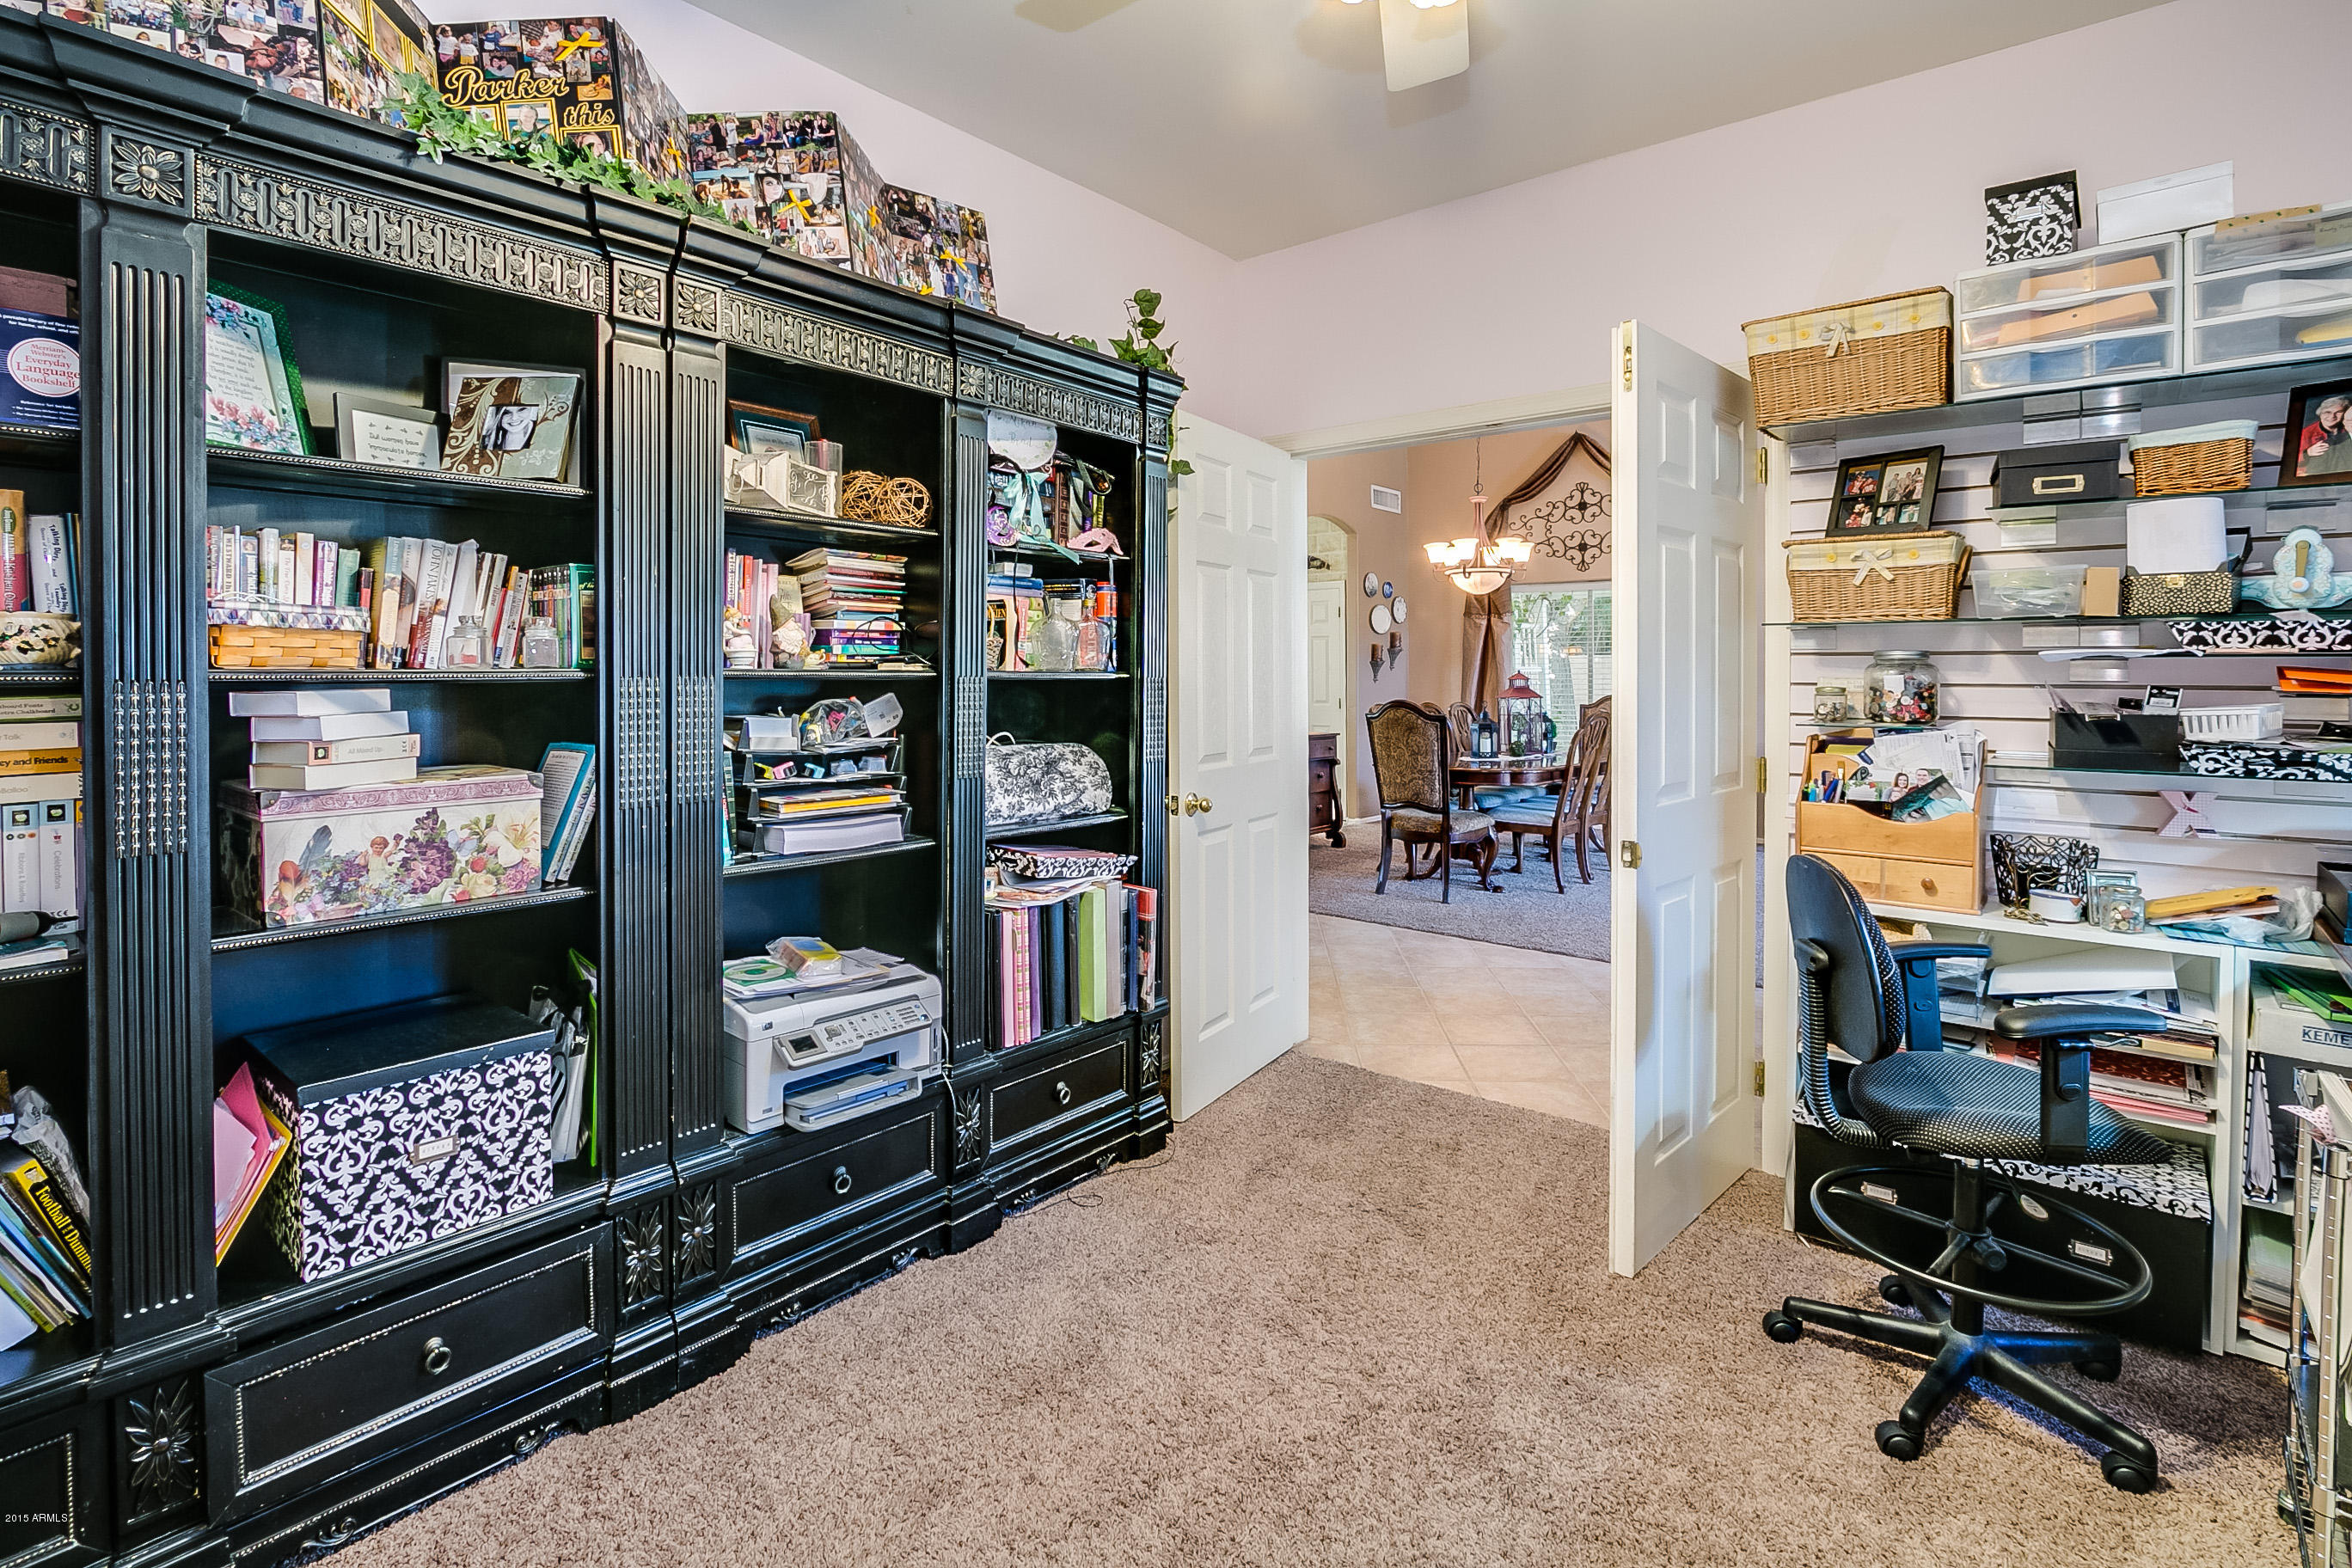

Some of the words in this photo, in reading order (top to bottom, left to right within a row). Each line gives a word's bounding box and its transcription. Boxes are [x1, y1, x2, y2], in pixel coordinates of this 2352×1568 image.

[441, 65, 570, 107] Parker
[563, 101, 616, 127] this
[30, 344, 66, 353] Merriam-
[31, 349, 66, 359] Webster's
[16, 361, 81, 379] Language
[25, 355, 71, 369] Everyday
[21, 374, 76, 389] Bookshelf
[49, 524, 60, 546] Talking
[430, 543, 443, 572] JOHN
[426, 573, 439, 599] JAKES
[13, 757, 32, 766] and
[34, 756, 68, 764] Friends
[53, 850, 63, 890] Celebrations
[2301, 1028, 2349, 1046] KEME
[35, 1185, 71, 1228] Football
